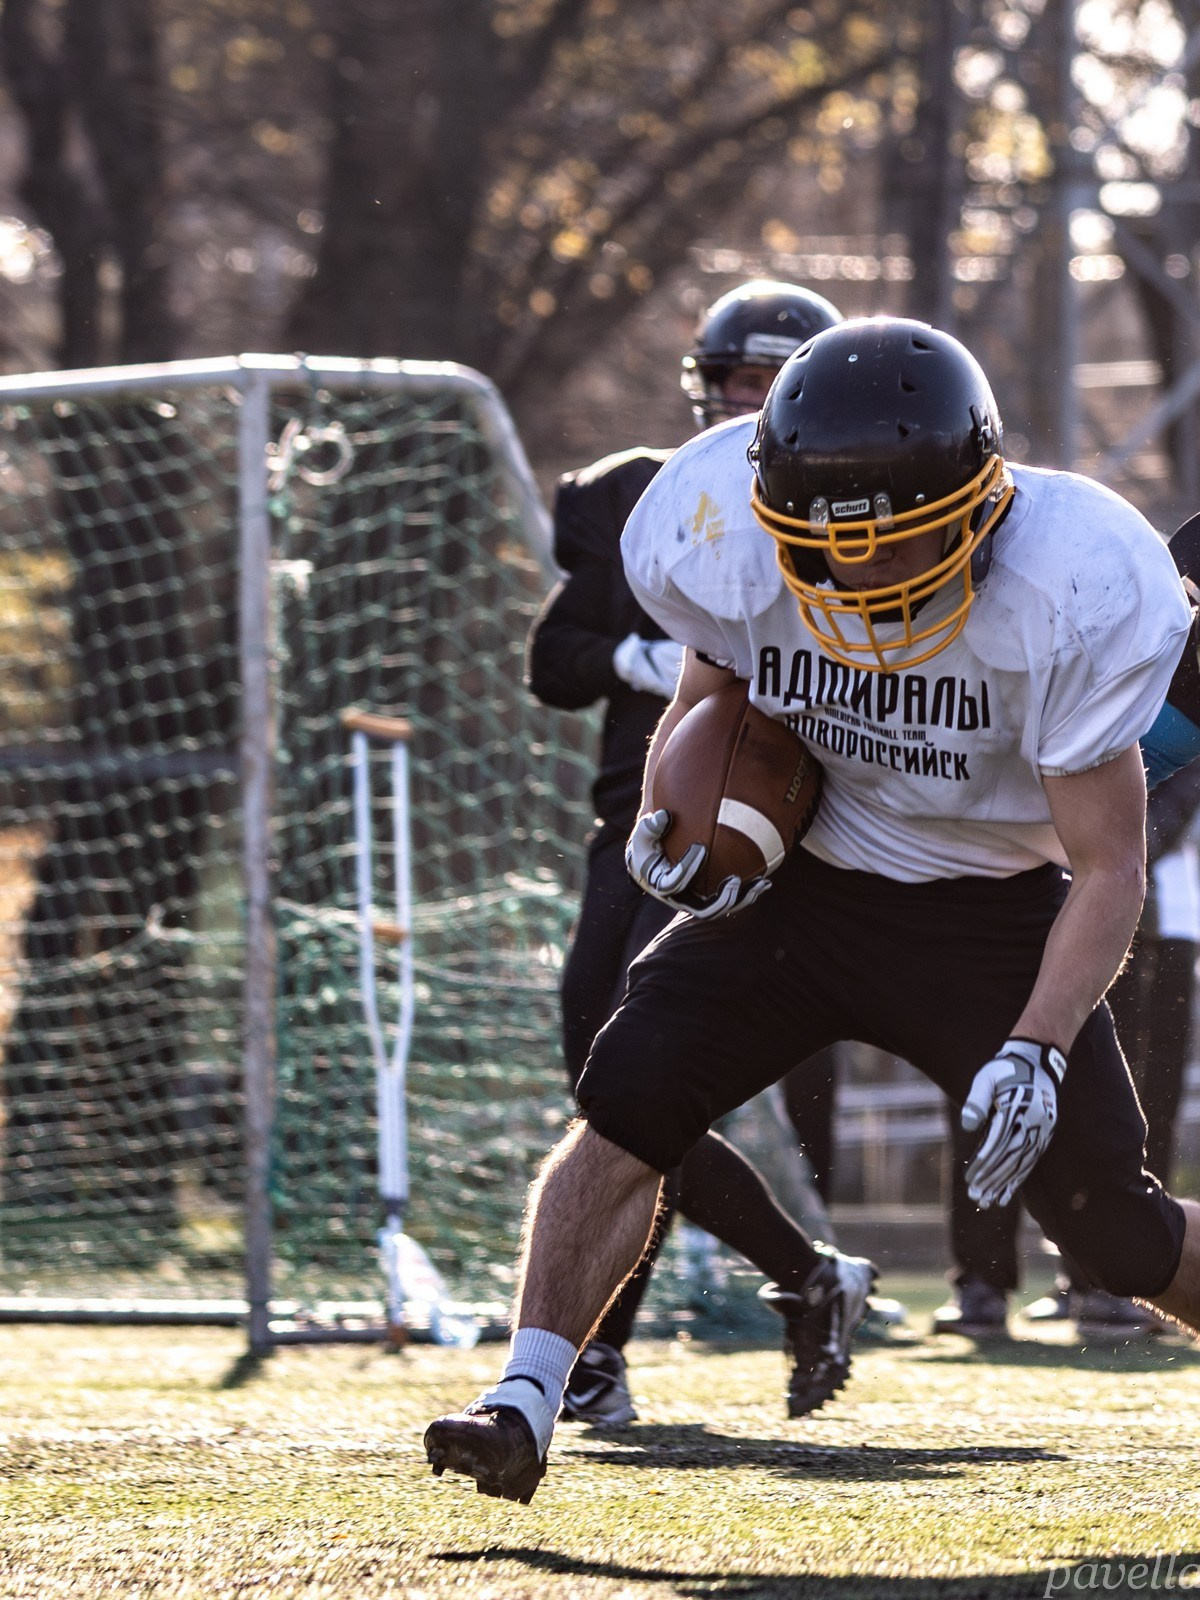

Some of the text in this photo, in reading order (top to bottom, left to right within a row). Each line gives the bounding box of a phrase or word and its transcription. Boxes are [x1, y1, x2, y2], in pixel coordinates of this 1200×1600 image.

[834, 502, 868, 514] schutt
[757, 645, 991, 731] АДМИРАЛЫ
[902, 730, 927, 741] TEAM
